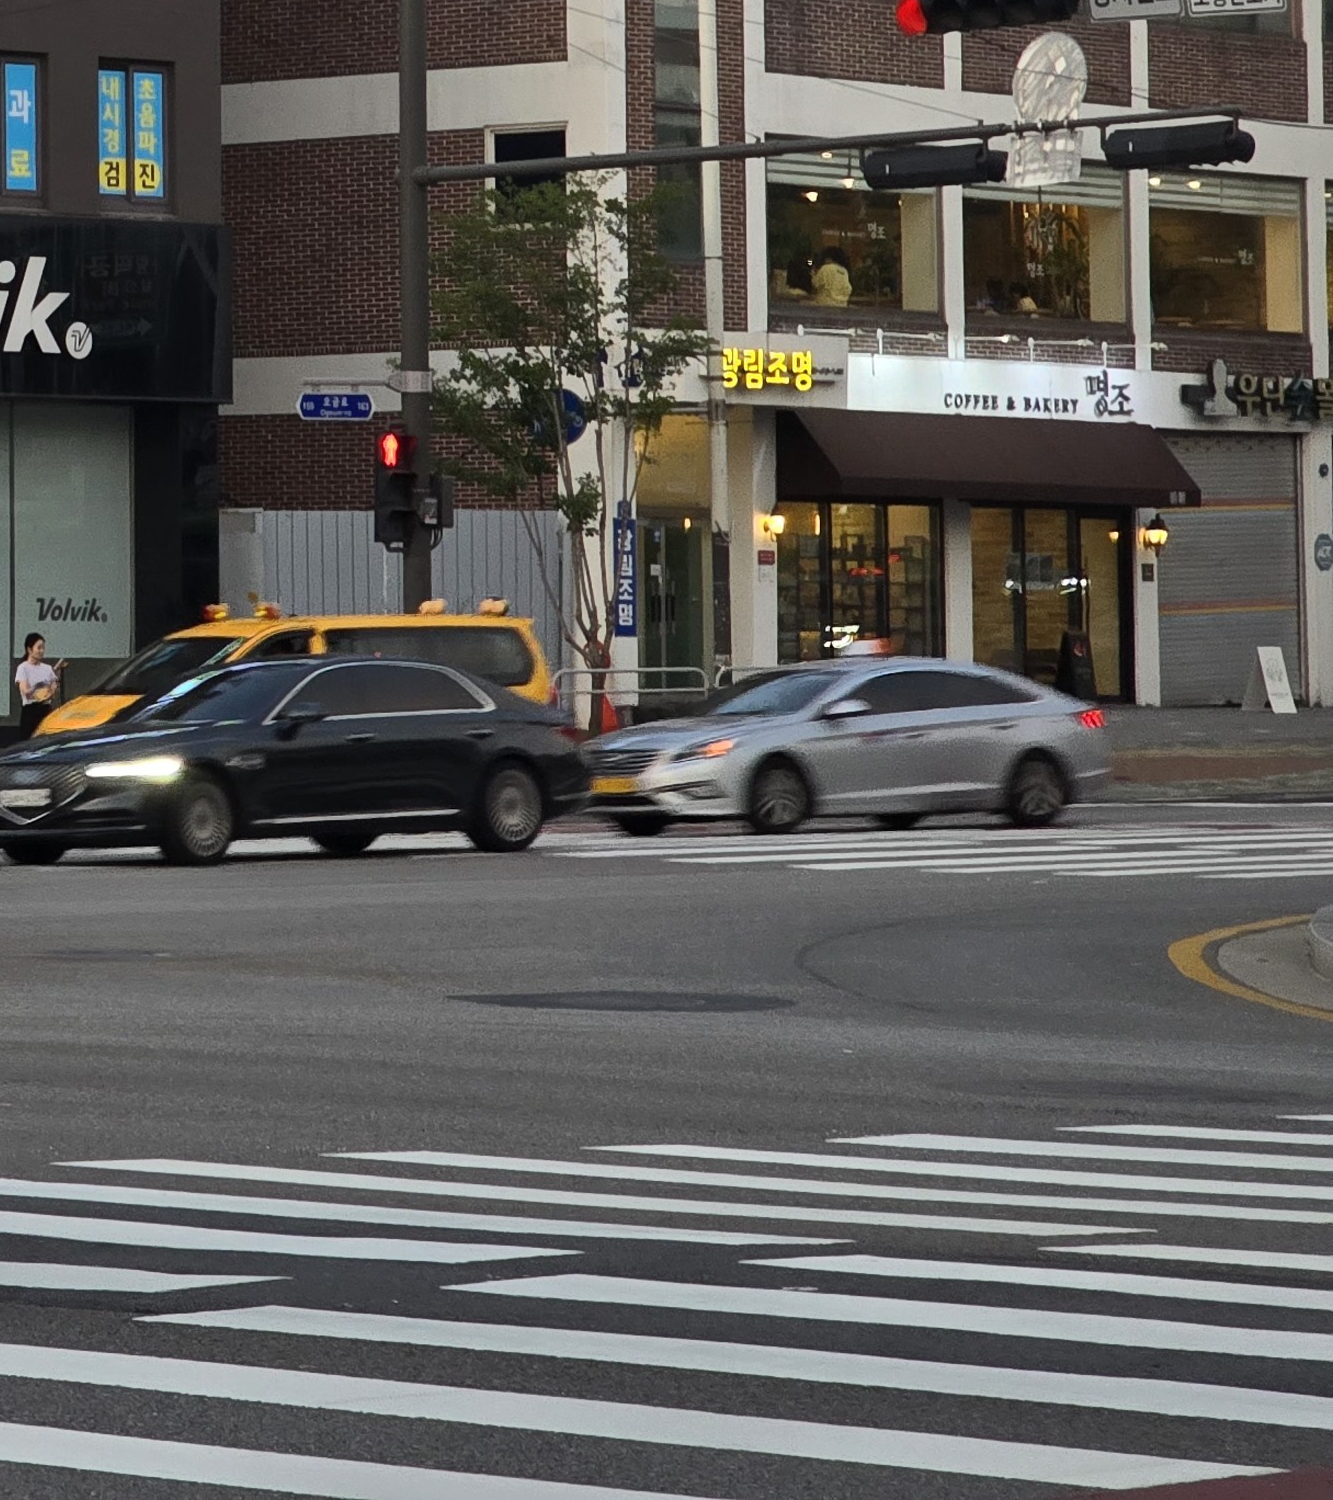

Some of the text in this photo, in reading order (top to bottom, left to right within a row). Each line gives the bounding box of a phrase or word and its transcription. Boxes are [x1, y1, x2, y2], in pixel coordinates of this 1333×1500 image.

[722, 347, 812, 392] 광림조명
[944, 393, 999, 411] COFFEE
[1023, 396, 1079, 414] BAKERY
[37, 597, 103, 622] Volvik
